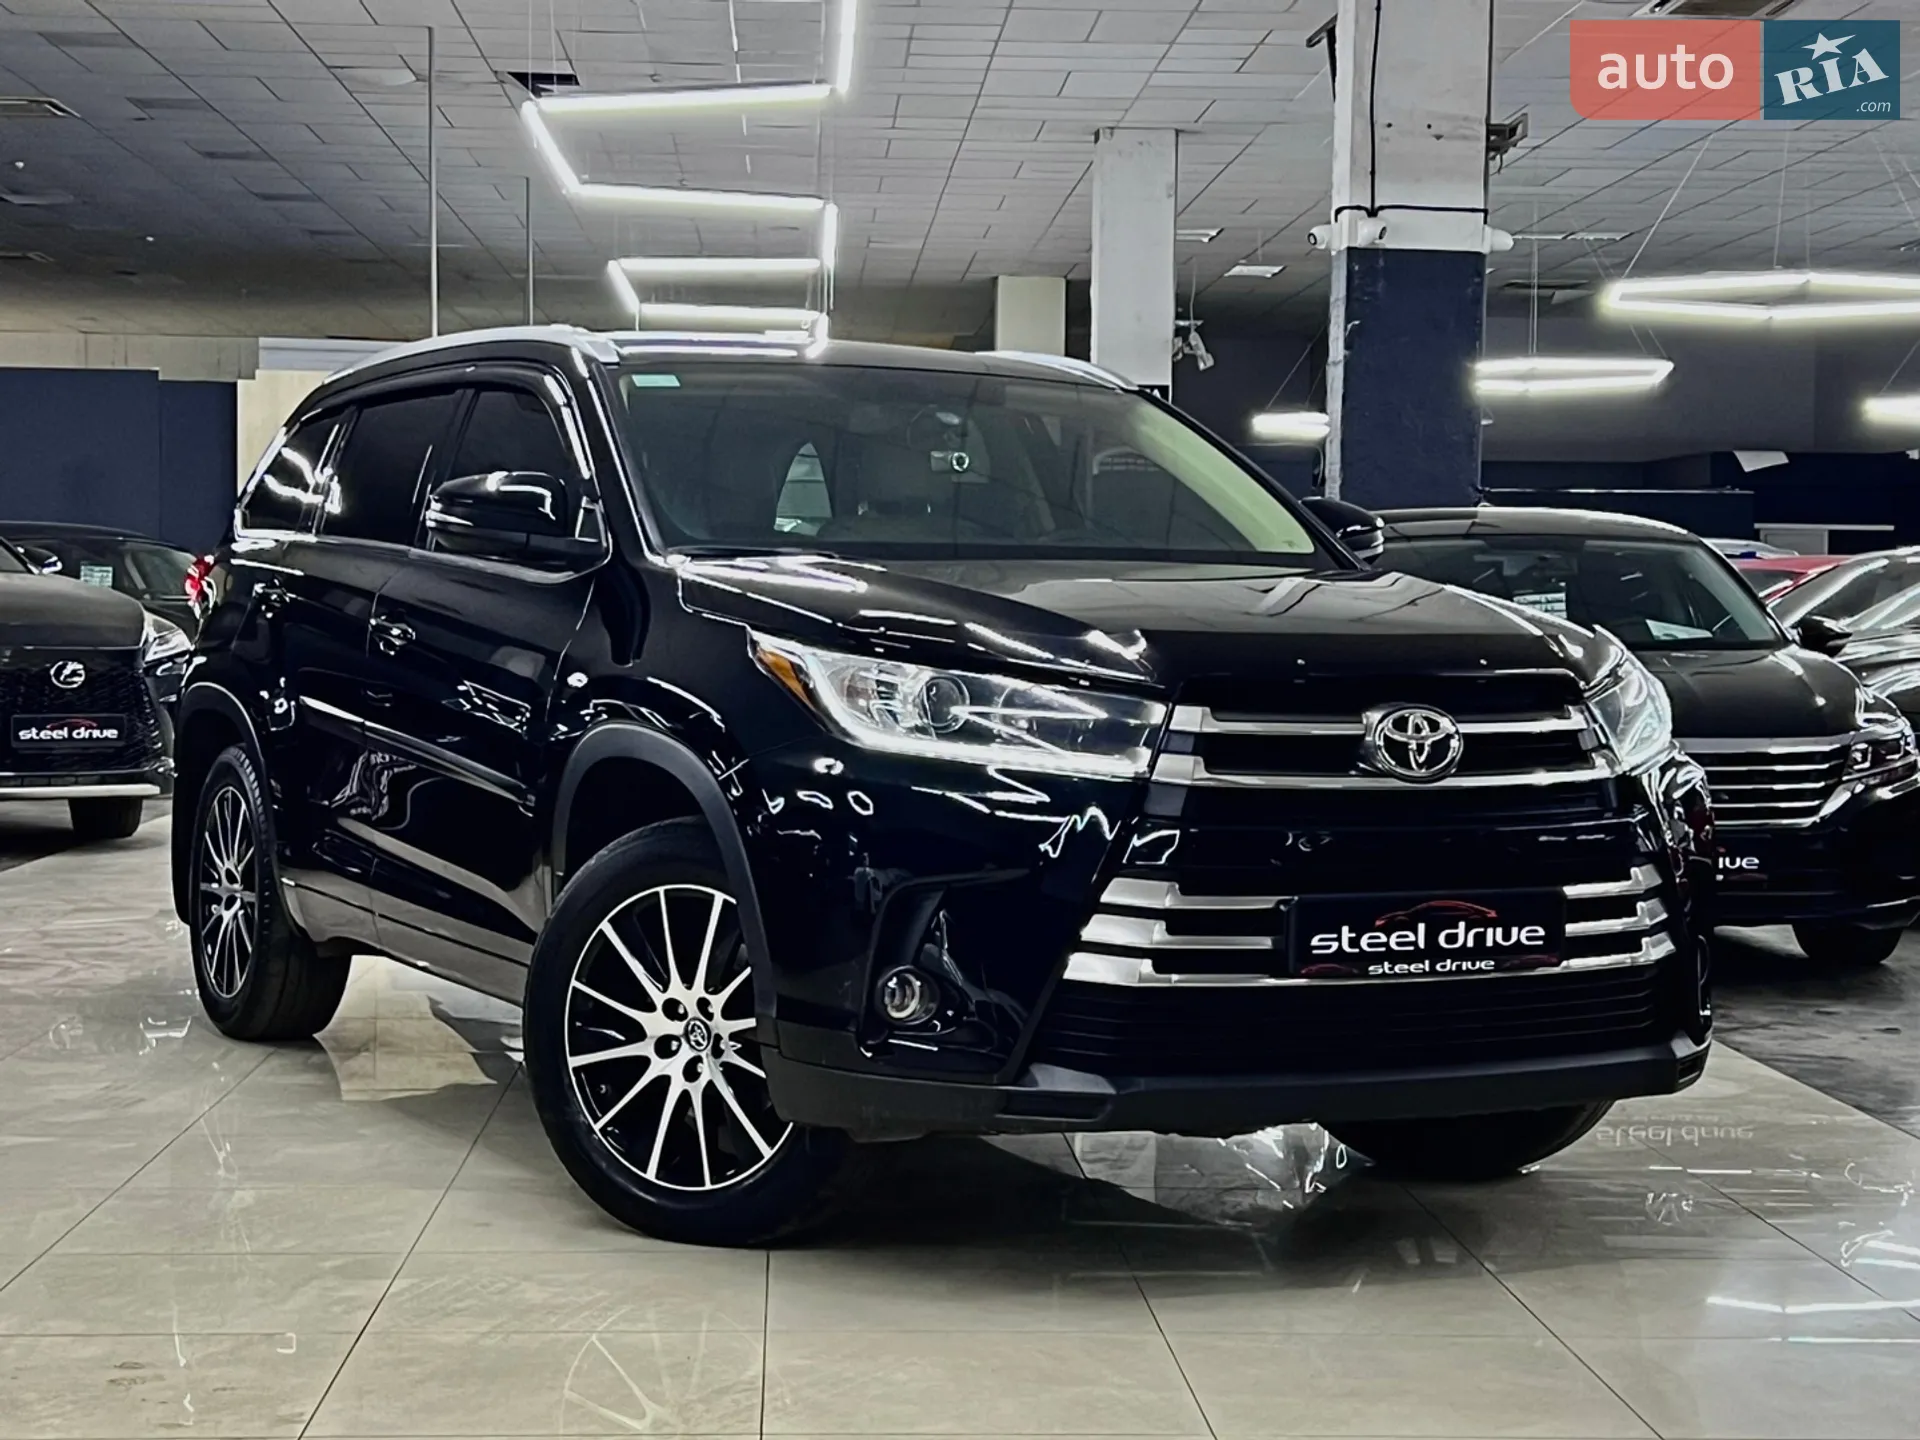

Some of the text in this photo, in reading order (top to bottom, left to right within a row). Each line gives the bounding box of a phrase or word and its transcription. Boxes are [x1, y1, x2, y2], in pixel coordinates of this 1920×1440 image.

[18, 727, 118, 740] steel drive
[1718, 857, 1760, 869] ive
[1310, 921, 1546, 954] steel drive
[1368, 959, 1495, 975] steel drive
